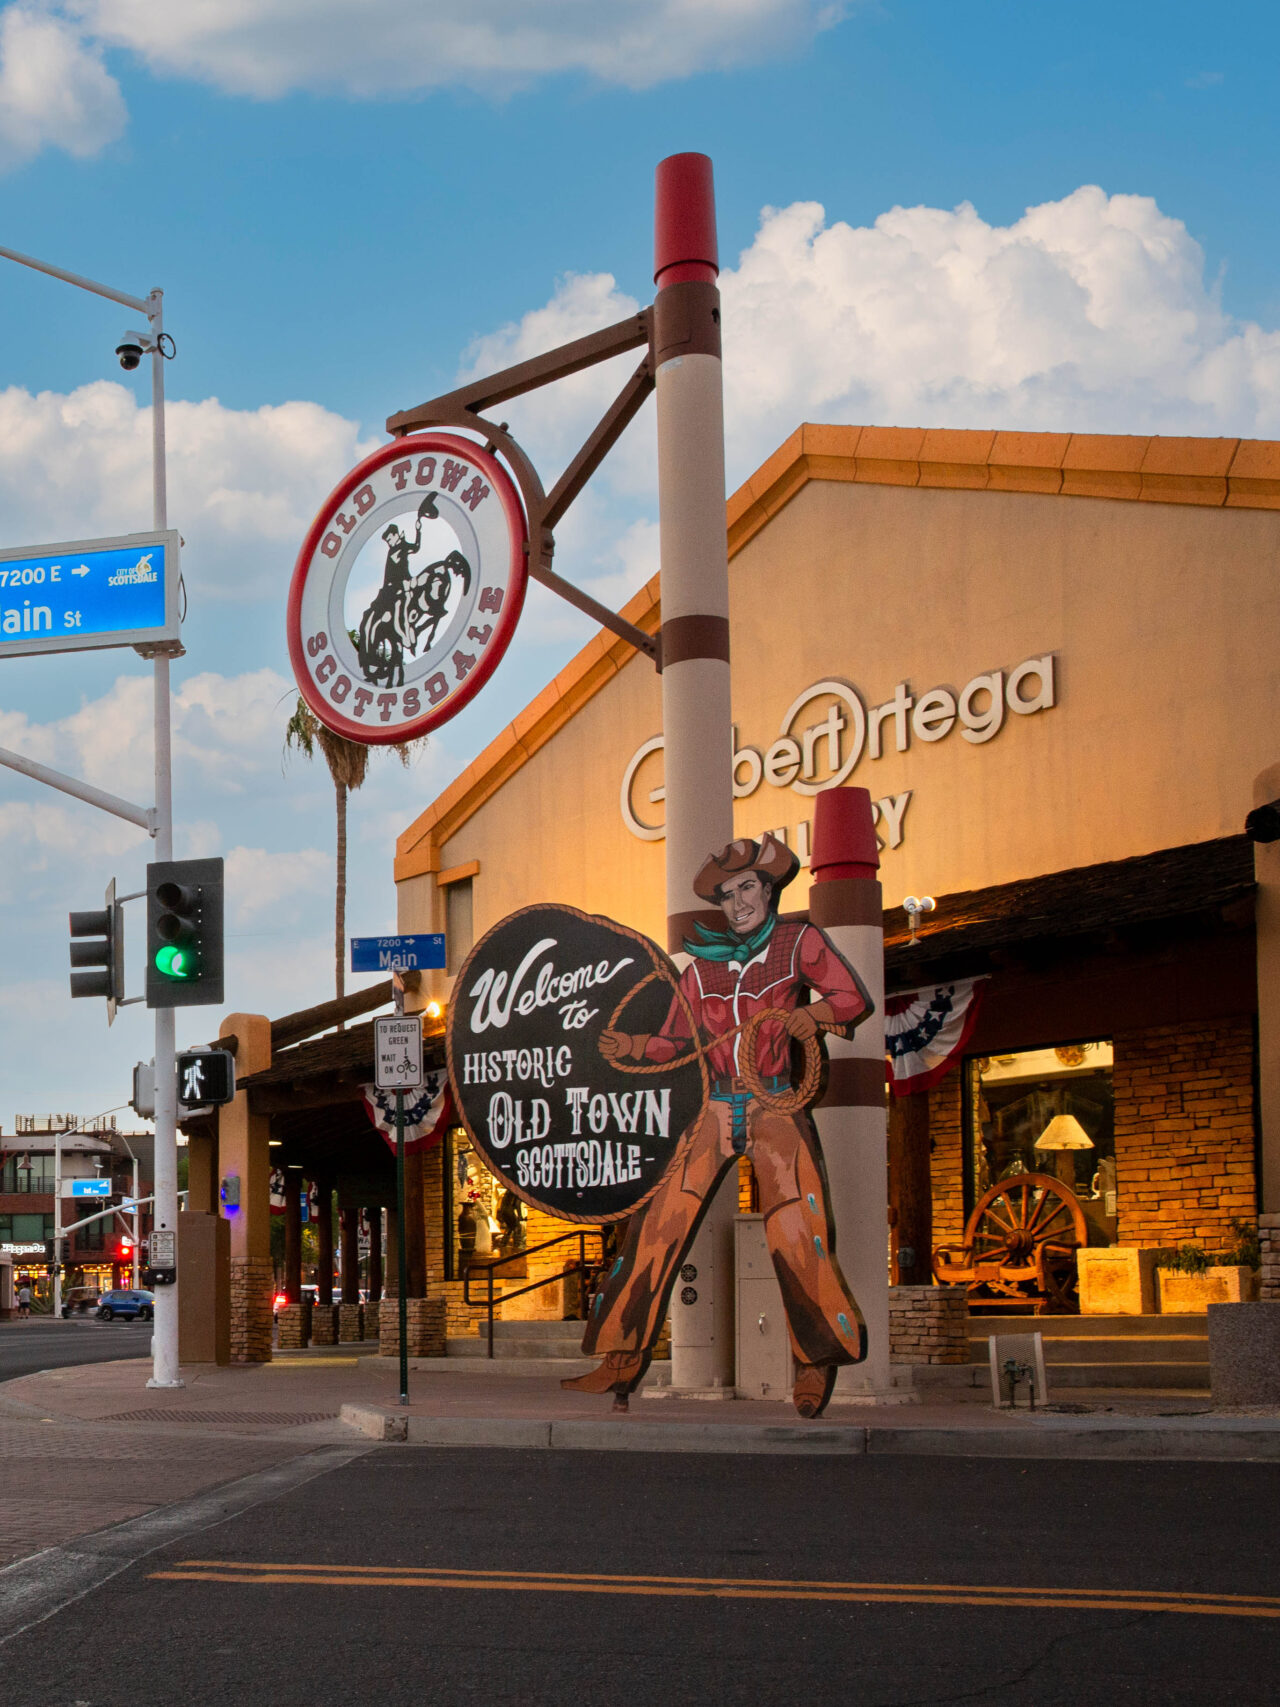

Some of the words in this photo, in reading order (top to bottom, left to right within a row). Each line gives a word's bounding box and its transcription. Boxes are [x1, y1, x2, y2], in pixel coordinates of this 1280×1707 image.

[321, 484, 376, 559] OLD
[391, 457, 490, 512] TOWN
[51, 566, 61, 582] E
[108, 572, 158, 587] SCOTTSDALE
[63, 611, 82, 628] St
[307, 586, 505, 722] SCOTTSDALE
[353, 940, 360, 949] E
[377, 938, 401, 947] 7200
[433, 936, 442, 945] St
[379, 949, 418, 968] Main
[469, 938, 635, 1034] Welcome
[558, 999, 599, 1030] to
[380, 1025, 387, 1033] TO
[390, 1023, 417, 1033] REQUEST
[388, 1036, 409, 1045] GREEN
[381, 1053, 396, 1062] WAIT
[463, 1045, 572, 1088] HISTORIC
[384, 1065, 394, 1074] ON
[486, 1091, 552, 1149] OLD
[565, 1087, 672, 1138] TOWN
[516, 1139, 642, 1189] SCOTTSDALE
